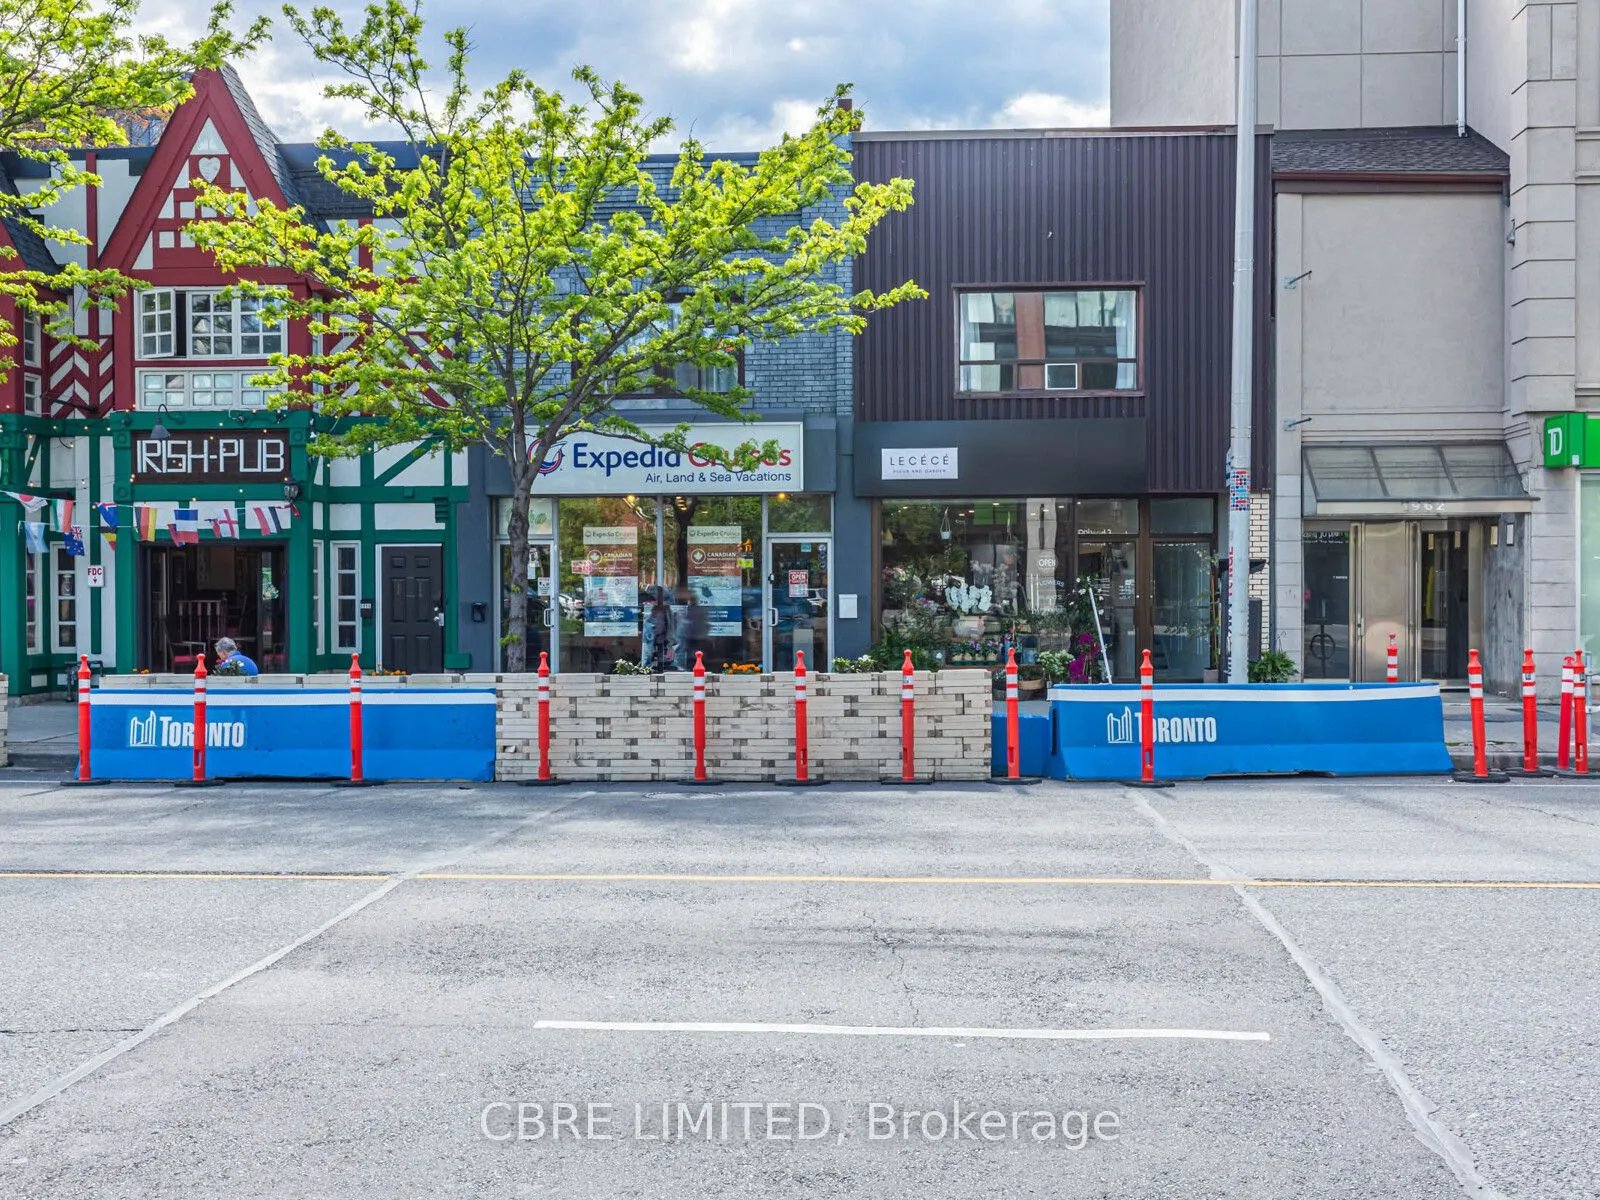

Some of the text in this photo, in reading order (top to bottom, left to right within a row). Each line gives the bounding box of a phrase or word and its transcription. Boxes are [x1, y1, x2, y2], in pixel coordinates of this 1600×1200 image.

[136, 438, 285, 474] IRISH-PUB
[1547, 426, 1563, 456] TD
[572, 442, 681, 478] Expedia
[644, 470, 792, 484] Air, Land & Sea Vacations
[87, 567, 103, 576] FDC
[1038, 558, 1057, 568] OPEN
[159, 715, 245, 748] TORNTO
